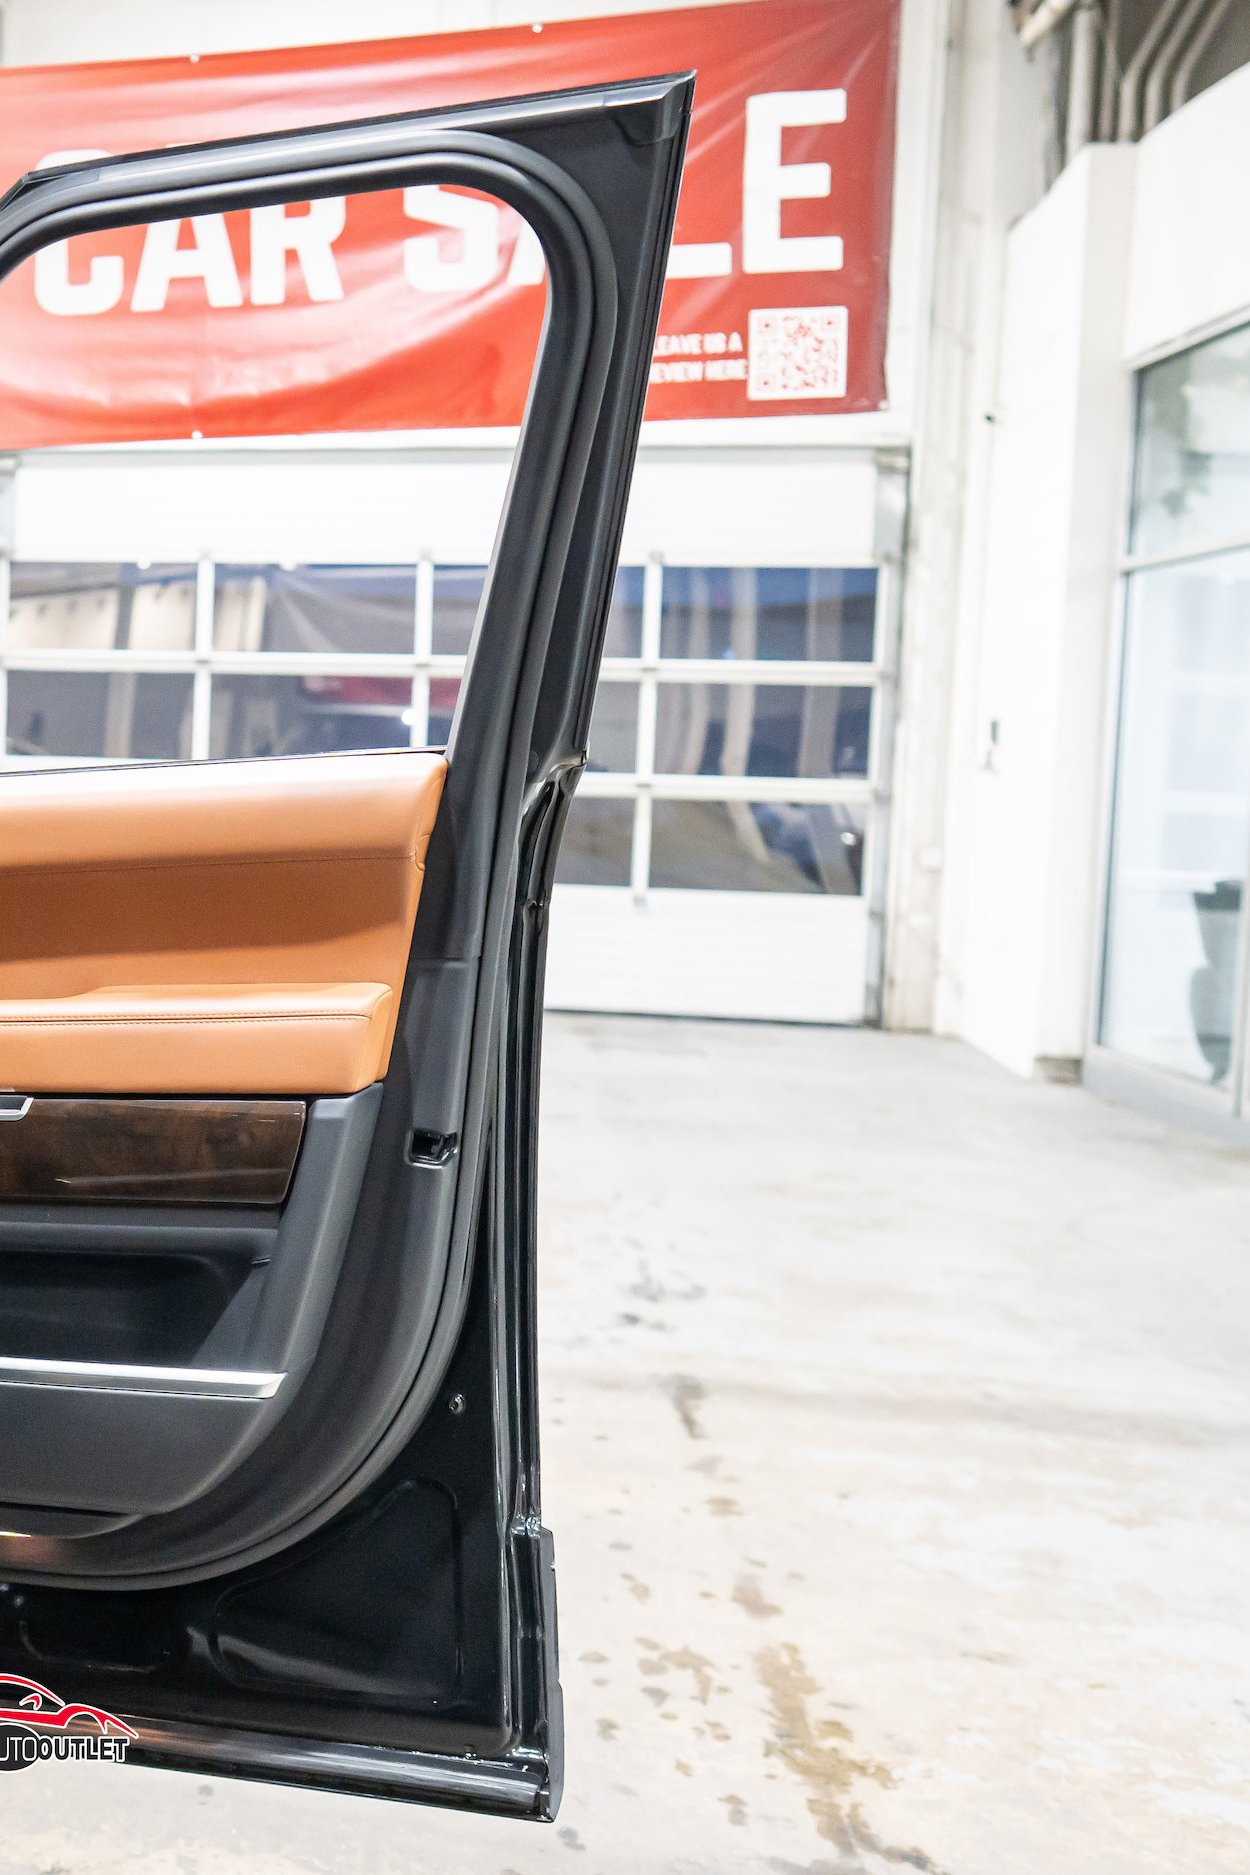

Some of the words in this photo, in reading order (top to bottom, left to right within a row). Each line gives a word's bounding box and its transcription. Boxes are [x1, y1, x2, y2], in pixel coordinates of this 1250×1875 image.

[33, 143, 346, 317] CAR
[403, 88, 847, 293] SE
[728, 331, 743, 352] A
